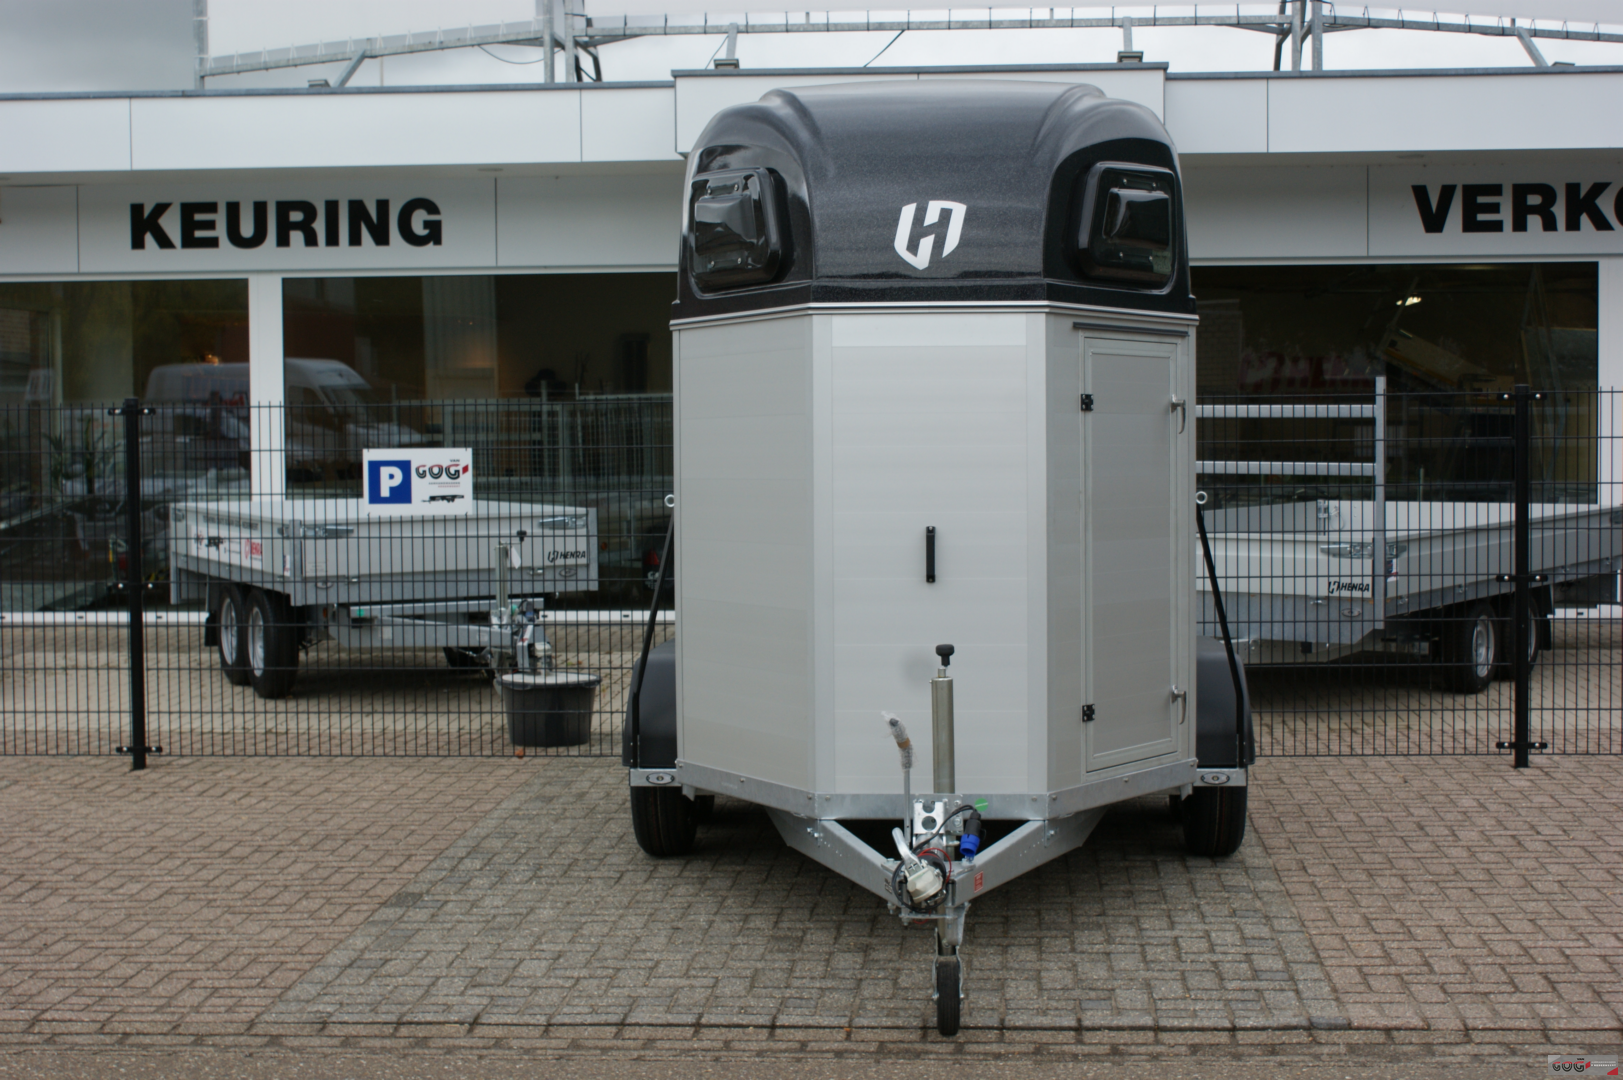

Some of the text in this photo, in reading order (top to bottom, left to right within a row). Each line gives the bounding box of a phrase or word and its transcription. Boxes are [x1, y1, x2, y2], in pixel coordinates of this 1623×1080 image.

[130, 197, 442, 250] KEURING
[1411, 182, 1623, 233] VERK
[380, 463, 460, 497] P GOG
[559, 550, 586, 560] HENRA
[1340, 582, 1370, 592] HENRA
